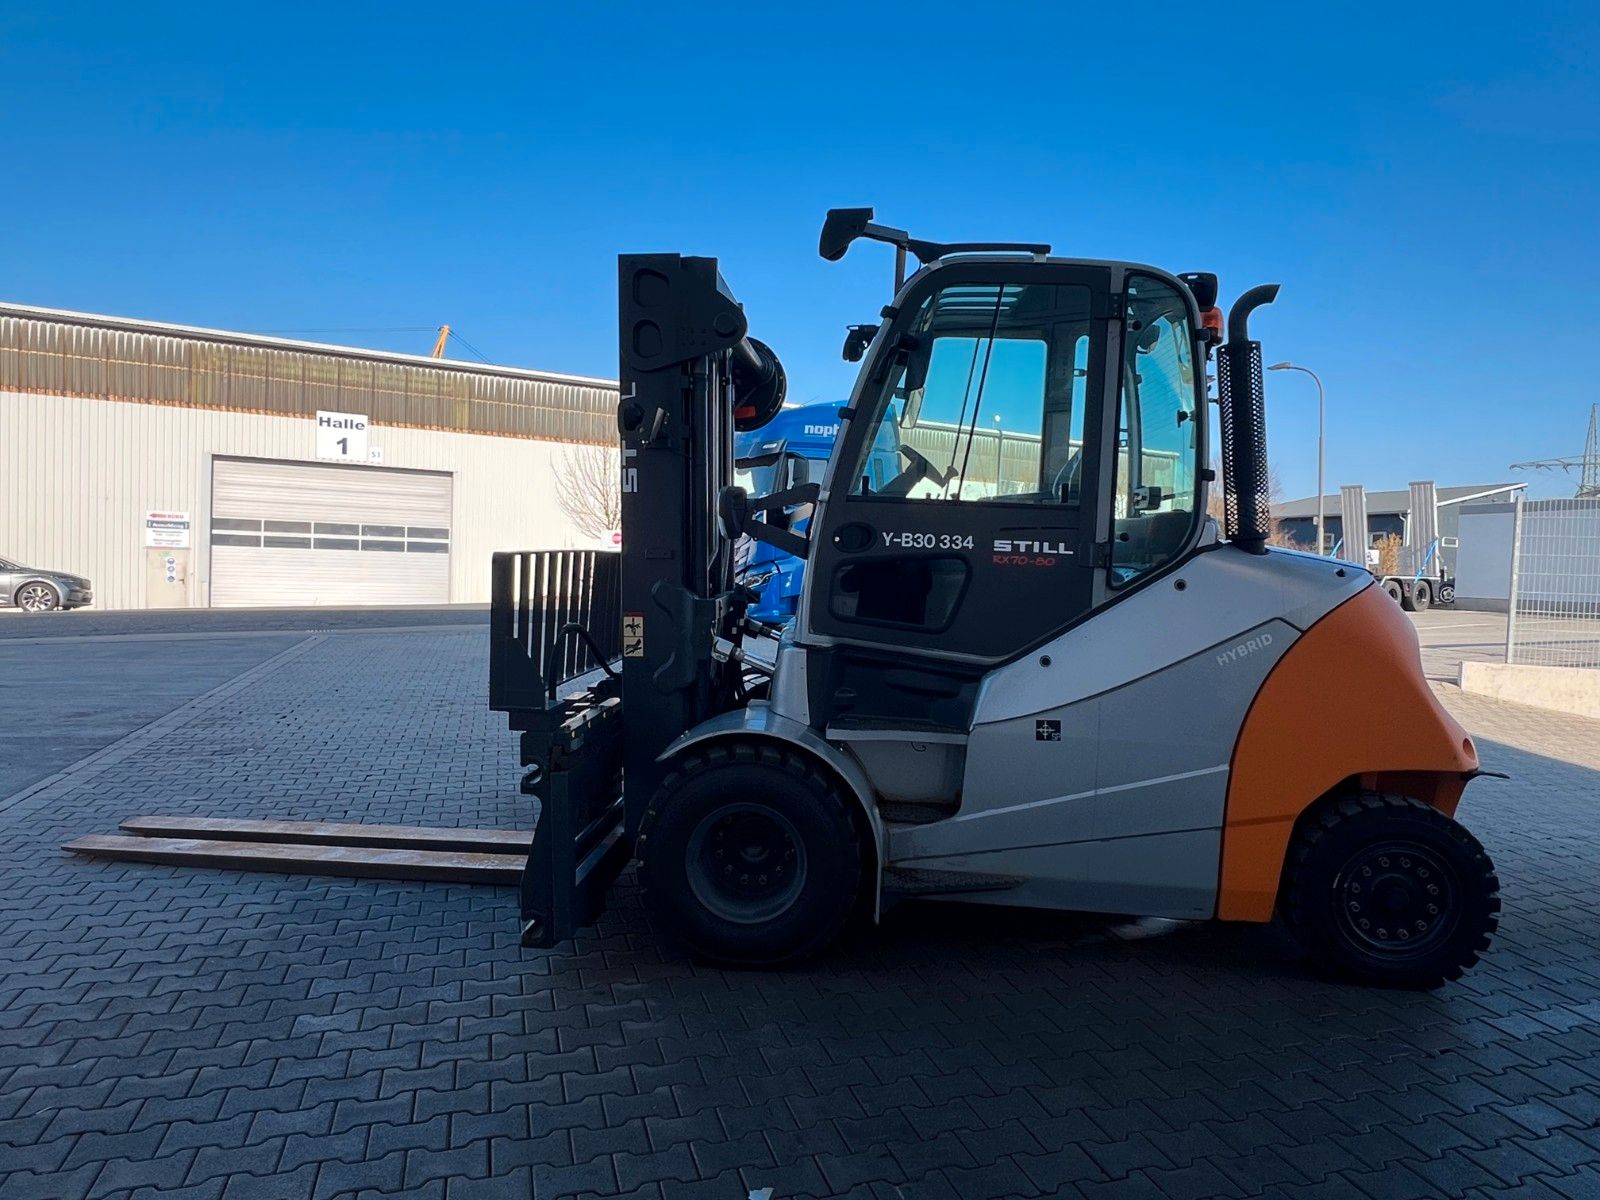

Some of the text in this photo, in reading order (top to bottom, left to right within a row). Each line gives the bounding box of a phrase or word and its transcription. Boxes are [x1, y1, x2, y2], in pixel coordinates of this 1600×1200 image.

[319, 416, 366, 431] Halle
[336, 437, 348, 455] 1
[621, 381, 638, 493] STL
[882, 532, 975, 550] Y-B30 334
[993, 539, 1074, 555] STILL
[1215, 633, 1273, 666] HYBRID
